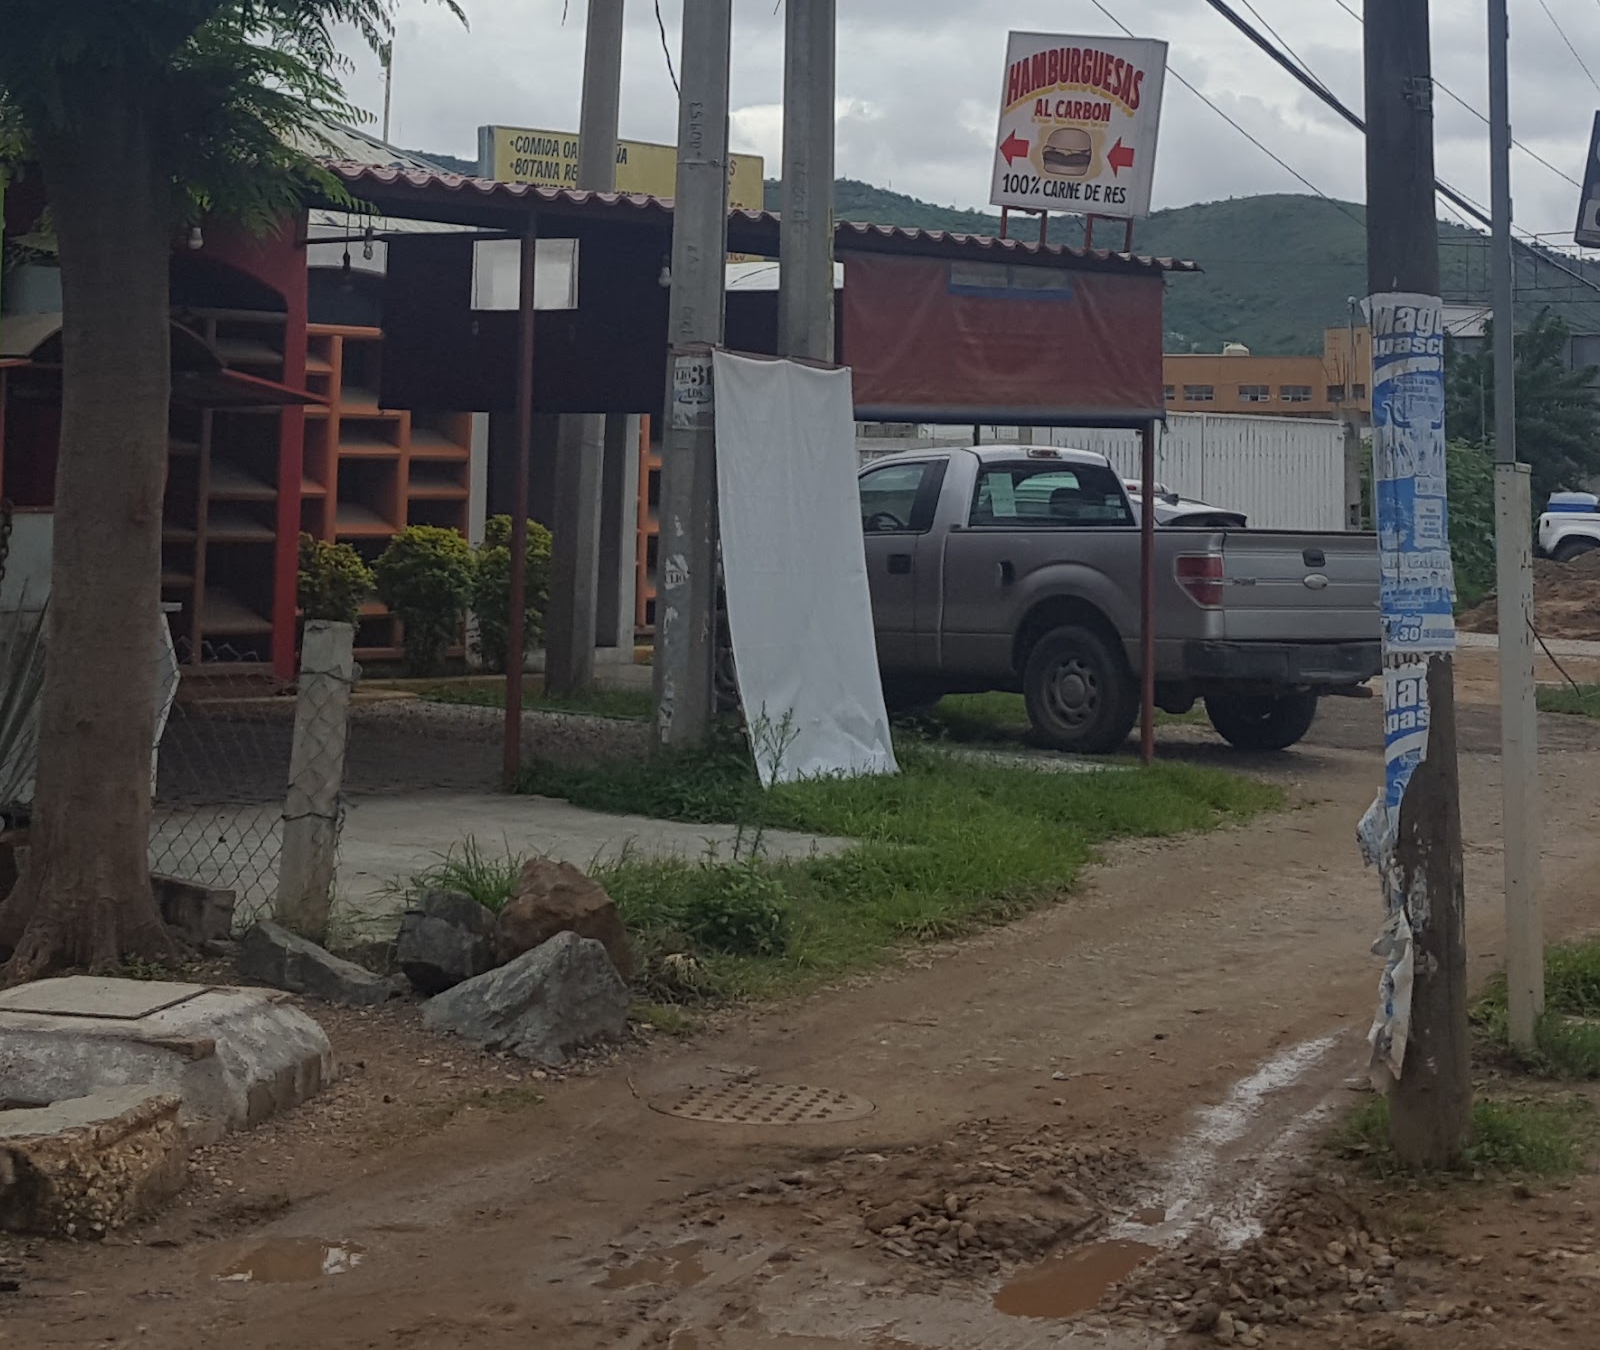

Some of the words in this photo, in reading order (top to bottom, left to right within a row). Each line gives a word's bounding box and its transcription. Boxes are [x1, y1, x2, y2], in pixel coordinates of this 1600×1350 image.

[1005, 47, 1145, 111] HAMBURGUESAS
[1034, 98, 1052, 118] AL
[1055, 100, 1111, 122] CARBON
[515, 136, 560, 159] COMIDA
[514, 158, 560, 180] BOTANA
[1002, 173, 1041, 195] 100%
[1043, 180, 1080, 200] CARNE
[1085, 185, 1100, 202] DE
[1104, 186, 1127, 204] RES
[1399, 626, 1421, 642] 30
